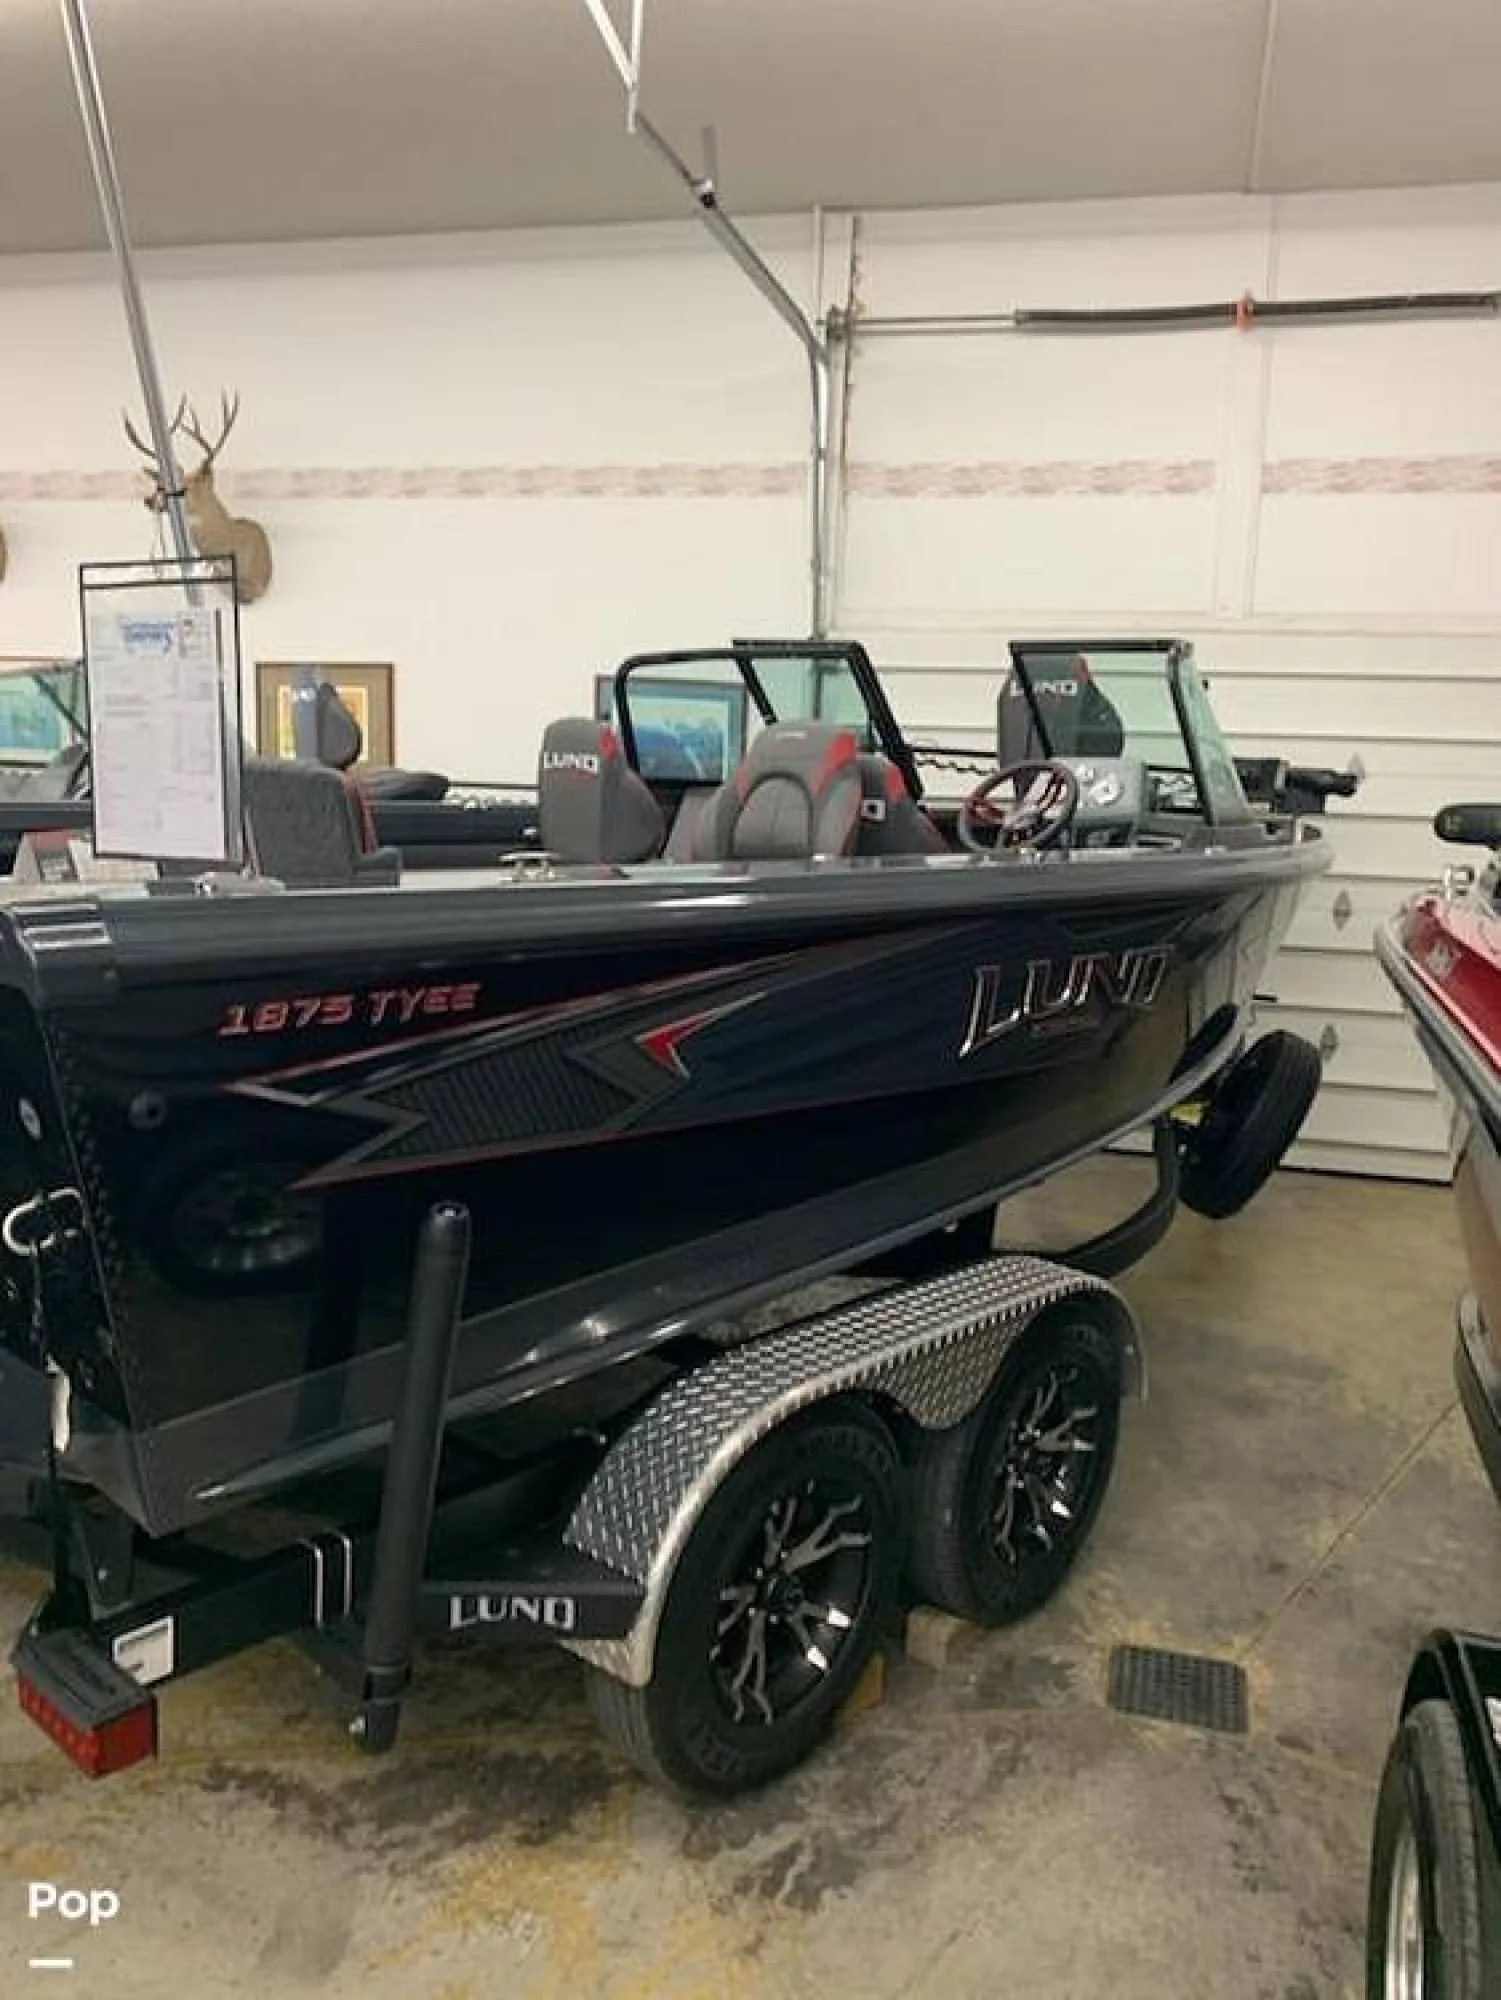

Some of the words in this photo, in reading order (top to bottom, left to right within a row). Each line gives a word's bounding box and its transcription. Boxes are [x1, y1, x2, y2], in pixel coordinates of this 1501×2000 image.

[543, 752, 598, 773] LUND
[218, 994, 354, 1036] 1875
[368, 983, 481, 1027] TYEE
[959, 944, 1174, 1057] LUND
[450, 1596, 574, 1630] LUND
